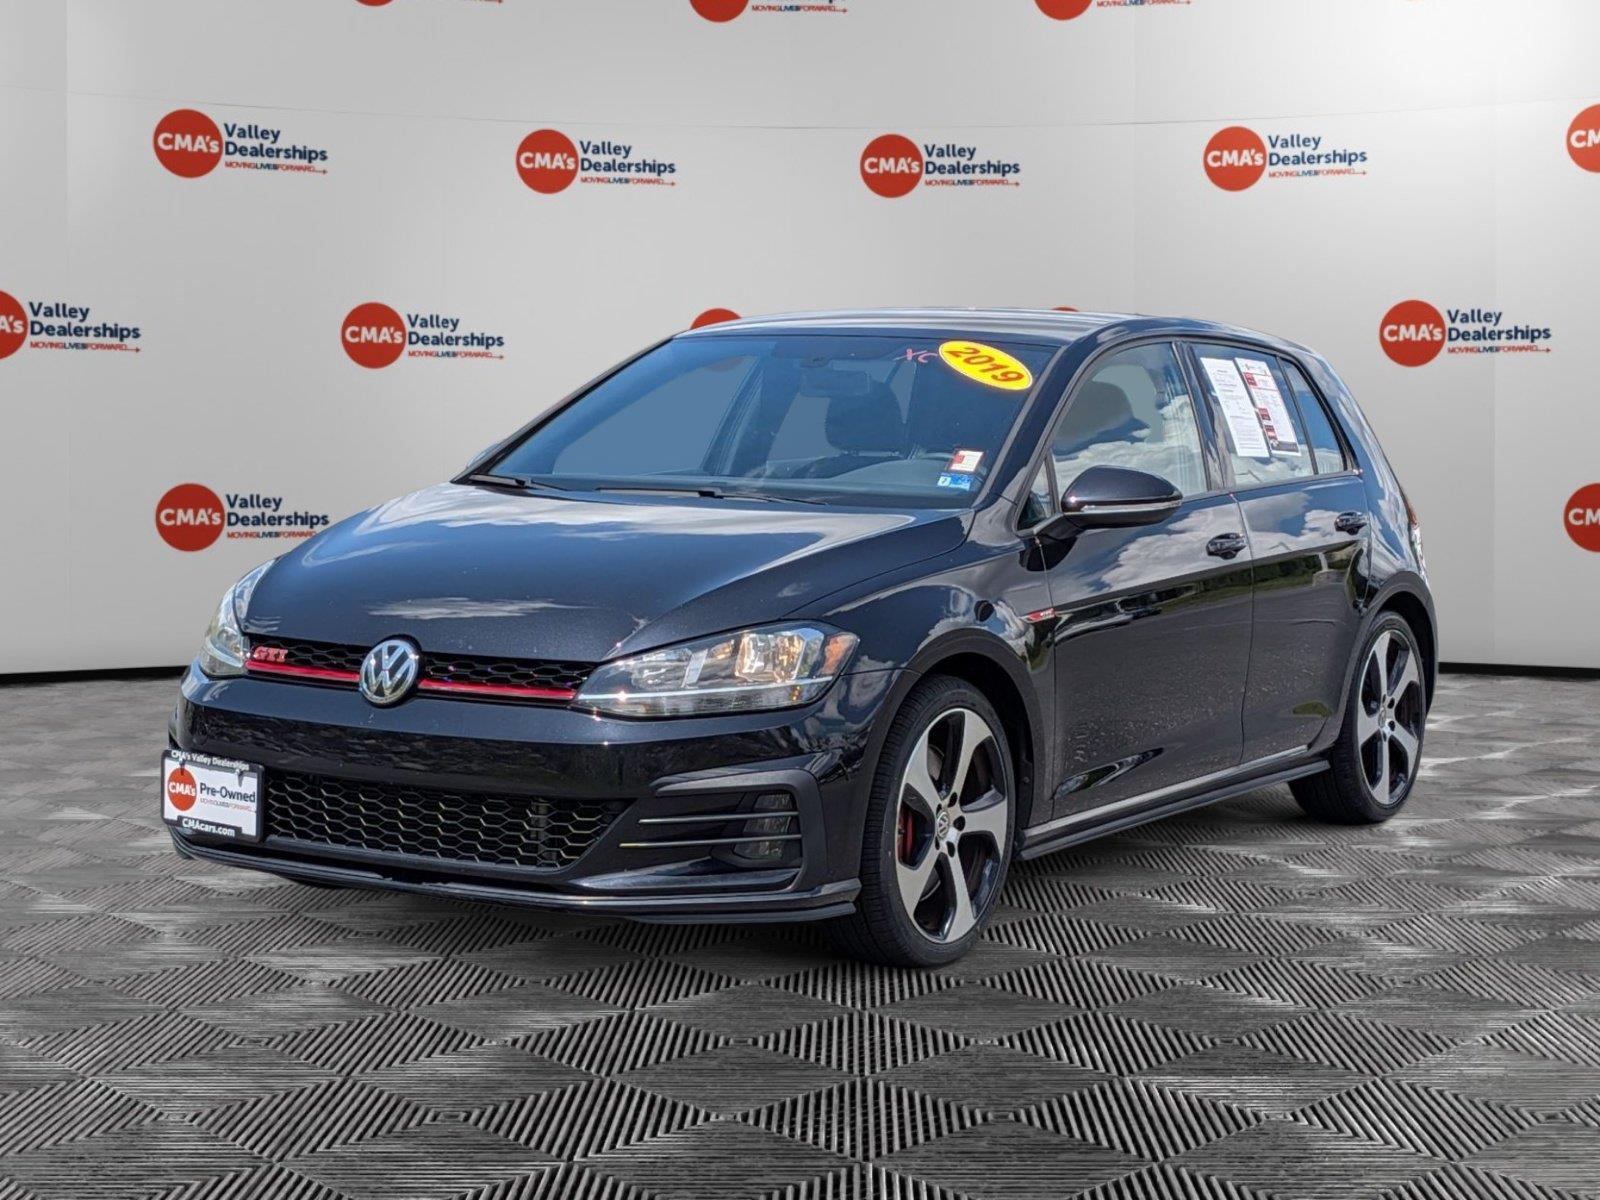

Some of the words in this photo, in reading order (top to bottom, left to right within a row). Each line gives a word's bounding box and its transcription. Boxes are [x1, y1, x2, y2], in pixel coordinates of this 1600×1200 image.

[224, 122, 280, 144] Valley
[157, 132, 219, 153] CMA's
[580, 141, 632, 158] Valley
[1268, 134, 1321, 151] Valley
[225, 142, 328, 163] Dealerships
[520, 152, 575, 170] CMA's
[924, 144, 976, 161] Valley
[1207, 149, 1264, 168] CMA's
[1269, 149, 1367, 166] Dealerships
[580, 158, 676, 176] Dealerships
[864, 157, 920, 174] CMA's
[925, 160, 1020, 177] Dealerships
[29, 301, 90, 323] Valley
[1447, 309, 1502, 327] Valley
[30, 320, 141, 342] Dealerships
[407, 314, 459, 332] Valley
[345, 326, 403, 344] CMA's
[408, 331, 504, 350] Dealerships
[1383, 323, 1443, 342] CMA's
[1448, 326, 1551, 343] Dealerships
[945, 347, 1025, 382] 2019
[226, 494, 282, 512] Valley
[160, 507, 222, 526] CMA's
[227, 511, 329, 529] Dealerships
[252, 646, 288, 663] GTI
[192, 753, 212, 766] Valley
[168, 781, 196, 797] CMA's
[200, 782, 256, 803] Pre-Owned
[182, 818, 236, 837] CMAcars.com
